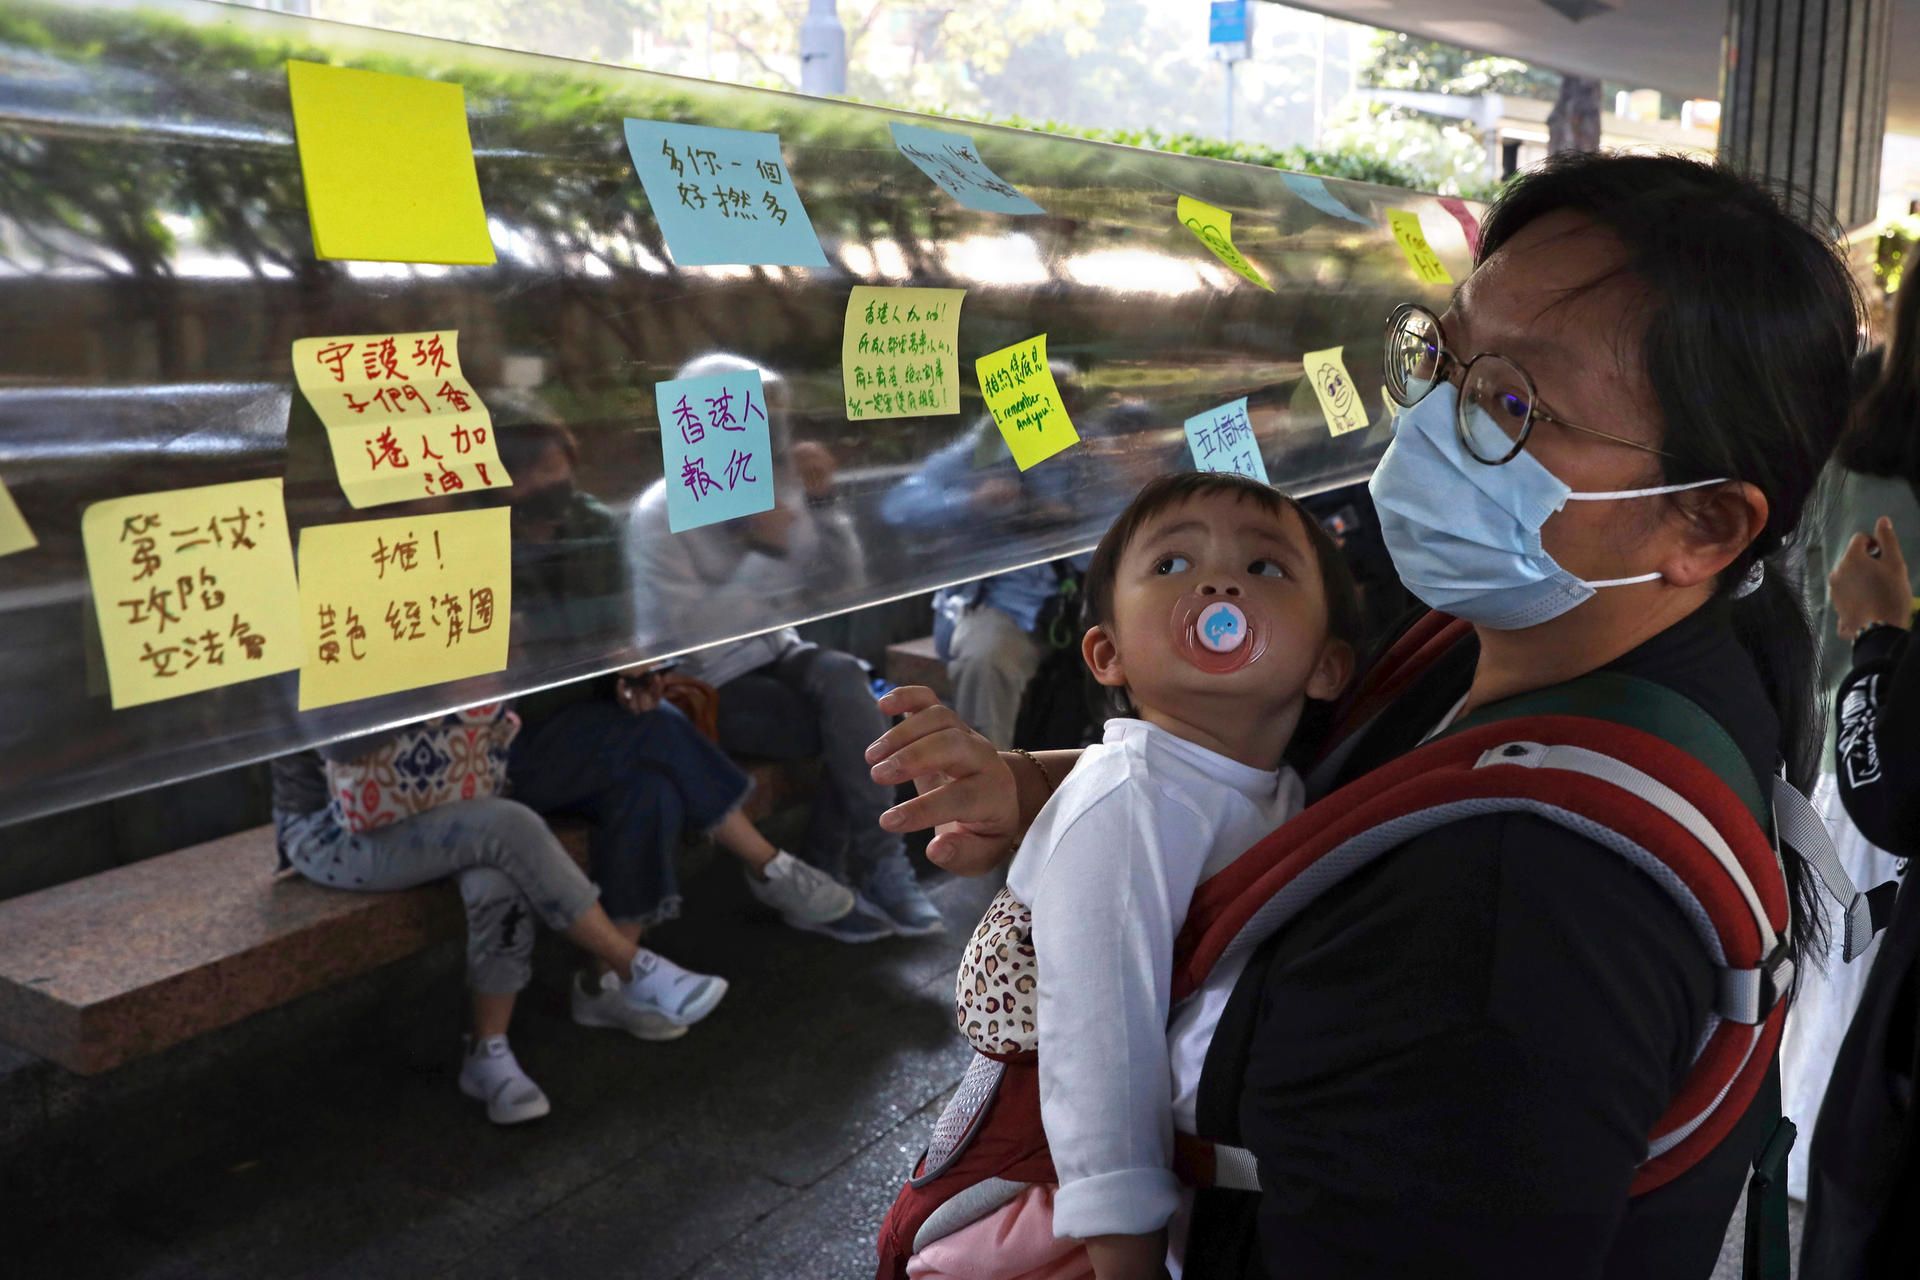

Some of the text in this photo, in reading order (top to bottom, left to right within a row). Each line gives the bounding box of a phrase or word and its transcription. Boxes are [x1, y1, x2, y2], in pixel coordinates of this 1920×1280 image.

[662, 139, 783, 185] 多你一個
[677, 182, 788, 226] 好撚多
[317, 334, 452, 382] 守護孩
[672, 386, 765, 444] 香港人
[993, 392, 1041, 425] I remember
[1195, 407, 1251, 460] 五大訴求
[366, 425, 487, 470] 港人加
[423, 462, 492, 495] 油！
[681, 449, 757, 502] 報仇
[120, 507, 266, 583] 第二仗：
[371, 530, 445, 580] 推！
[118, 566, 226, 634] 攻陷
[140, 613, 267, 677] 立法會
